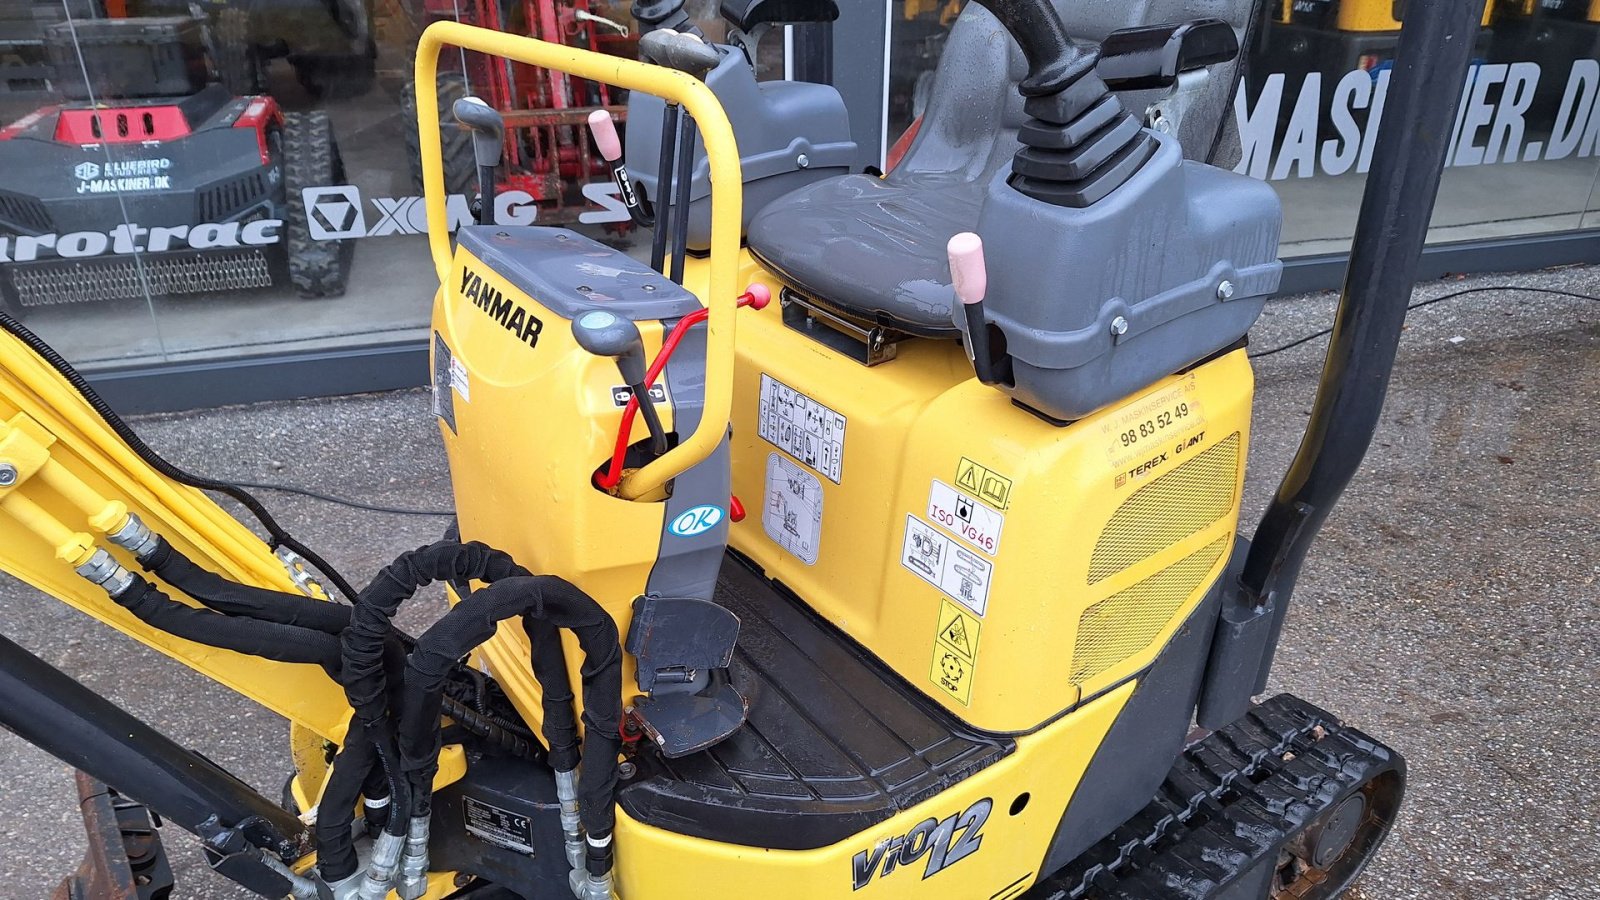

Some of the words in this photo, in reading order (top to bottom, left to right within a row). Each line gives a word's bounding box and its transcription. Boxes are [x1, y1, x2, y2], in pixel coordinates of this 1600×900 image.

[76, 175, 171, 194] J-MASKINER.DK
[461, 265, 544, 349] YANMAR
[1121, 429, 1137, 447] 98
[1139, 420, 1155, 438] 83
[1157, 411, 1173, 429] 52
[1175, 402, 1189, 419] 49
[1128, 451, 1167, 478] TEREX
[678, 508, 714, 533] OK
[930, 504, 954, 526] ISO
[961, 521, 994, 550] VG46
[940, 677, 958, 692] STOP
[514, 818, 527, 829] CE
